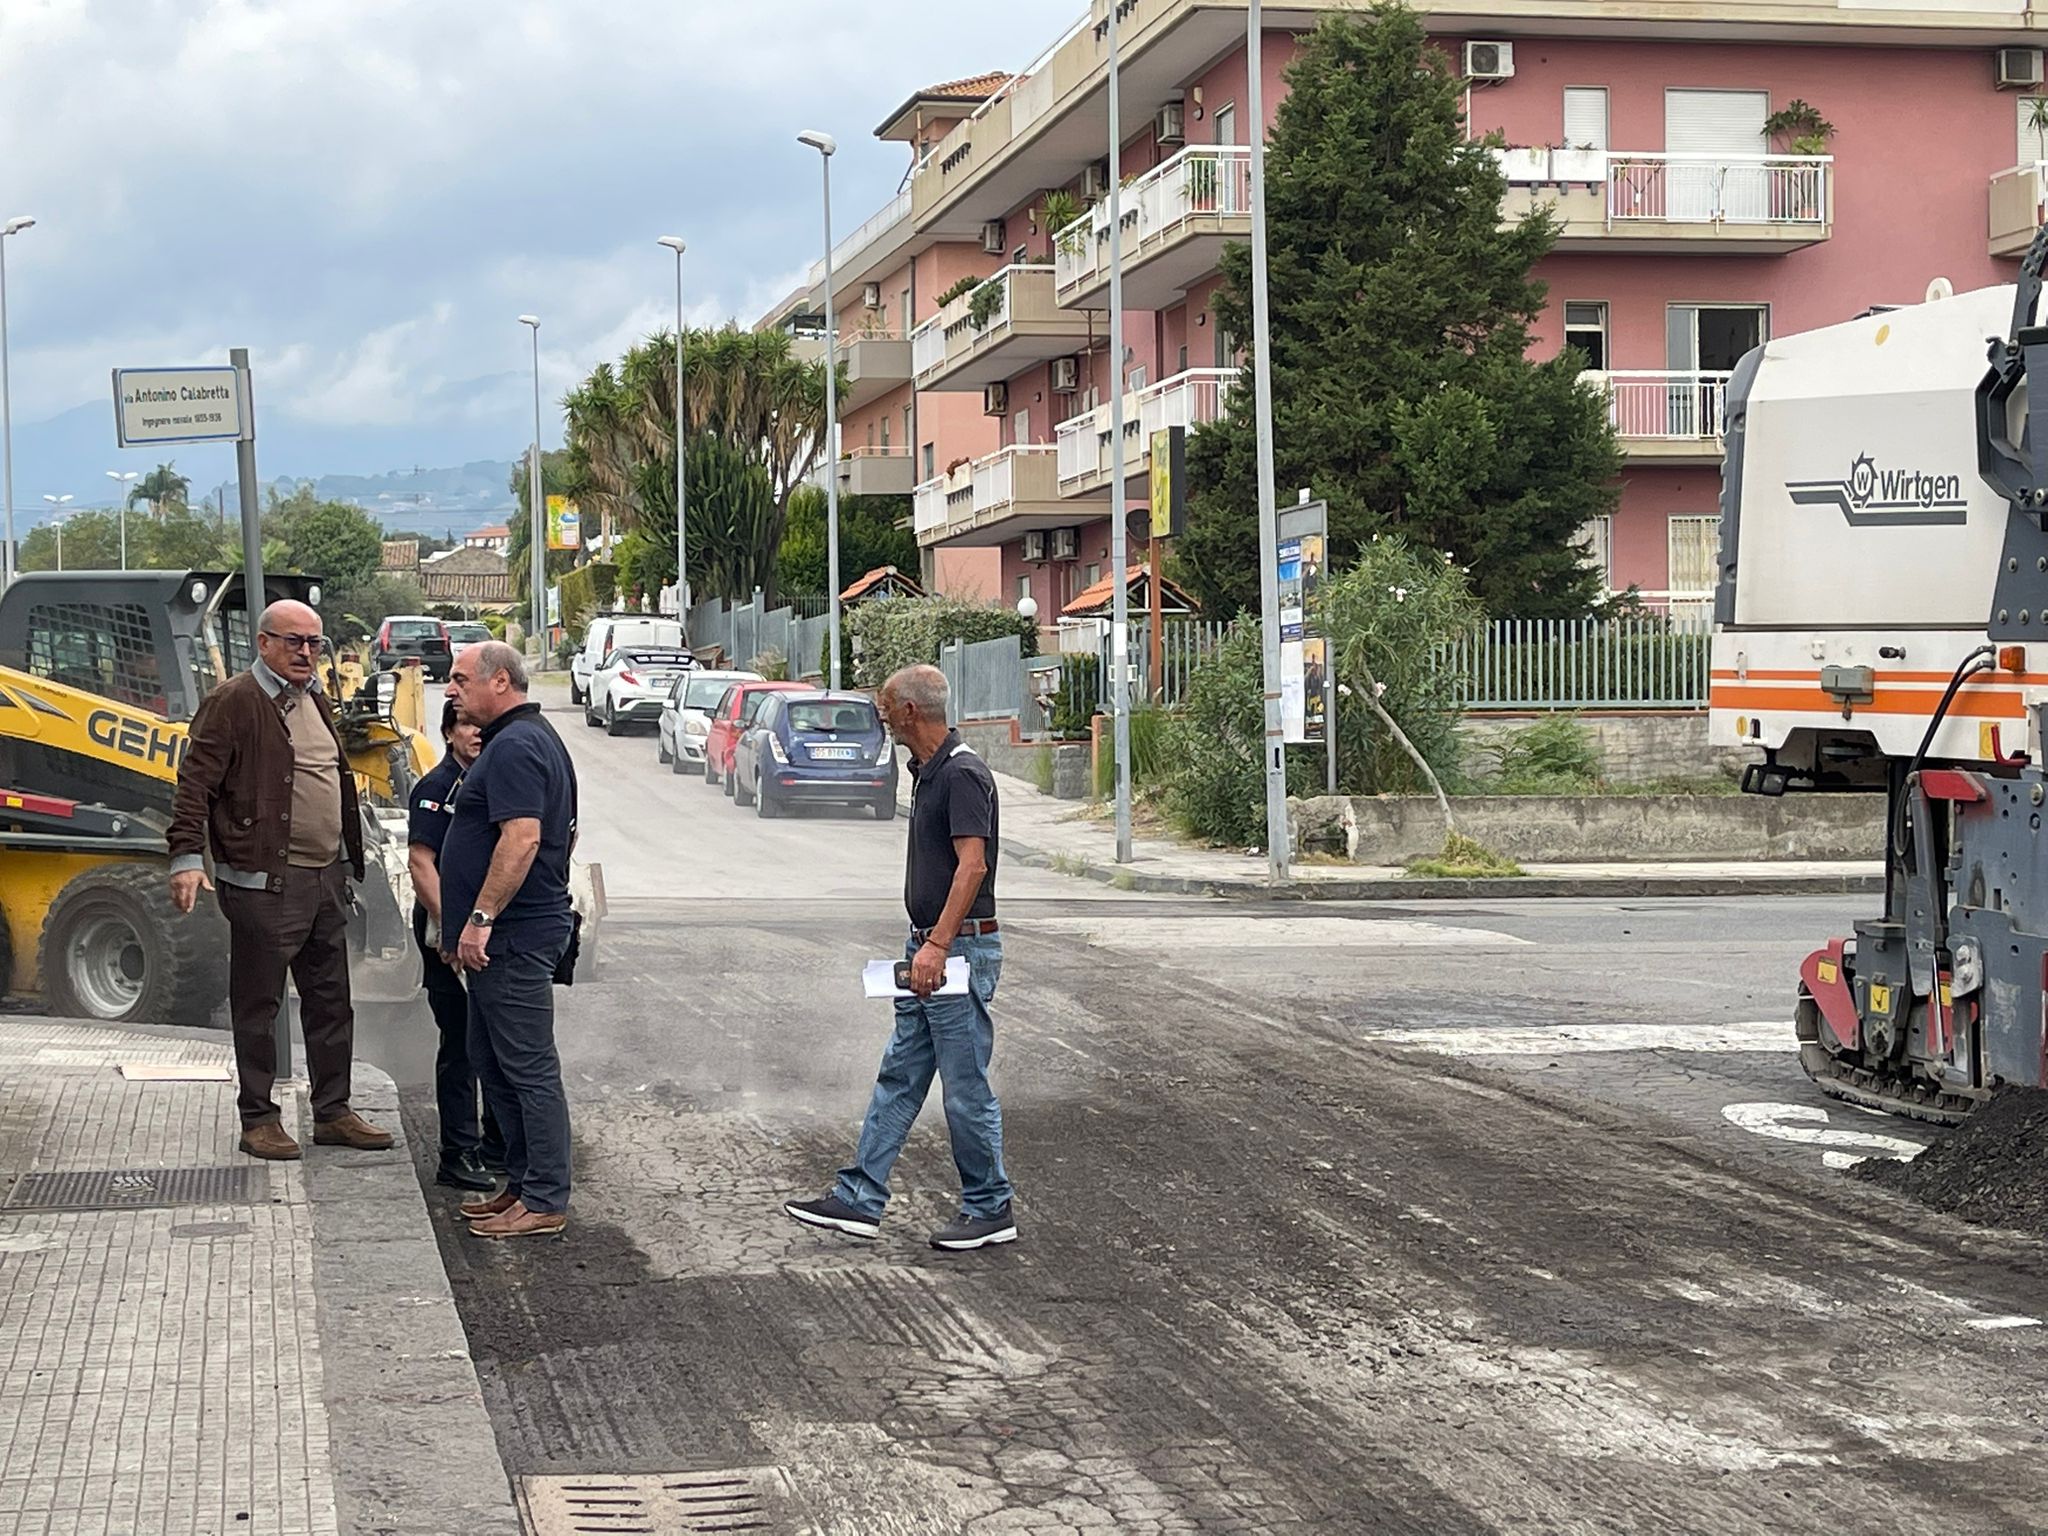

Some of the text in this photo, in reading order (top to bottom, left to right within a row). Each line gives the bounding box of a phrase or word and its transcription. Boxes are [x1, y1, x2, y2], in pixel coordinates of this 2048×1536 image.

[135, 387, 177, 403] Antonino
[180, 385, 230, 401] Calabretta
[1880, 469, 1959, 508] Wirtgen
